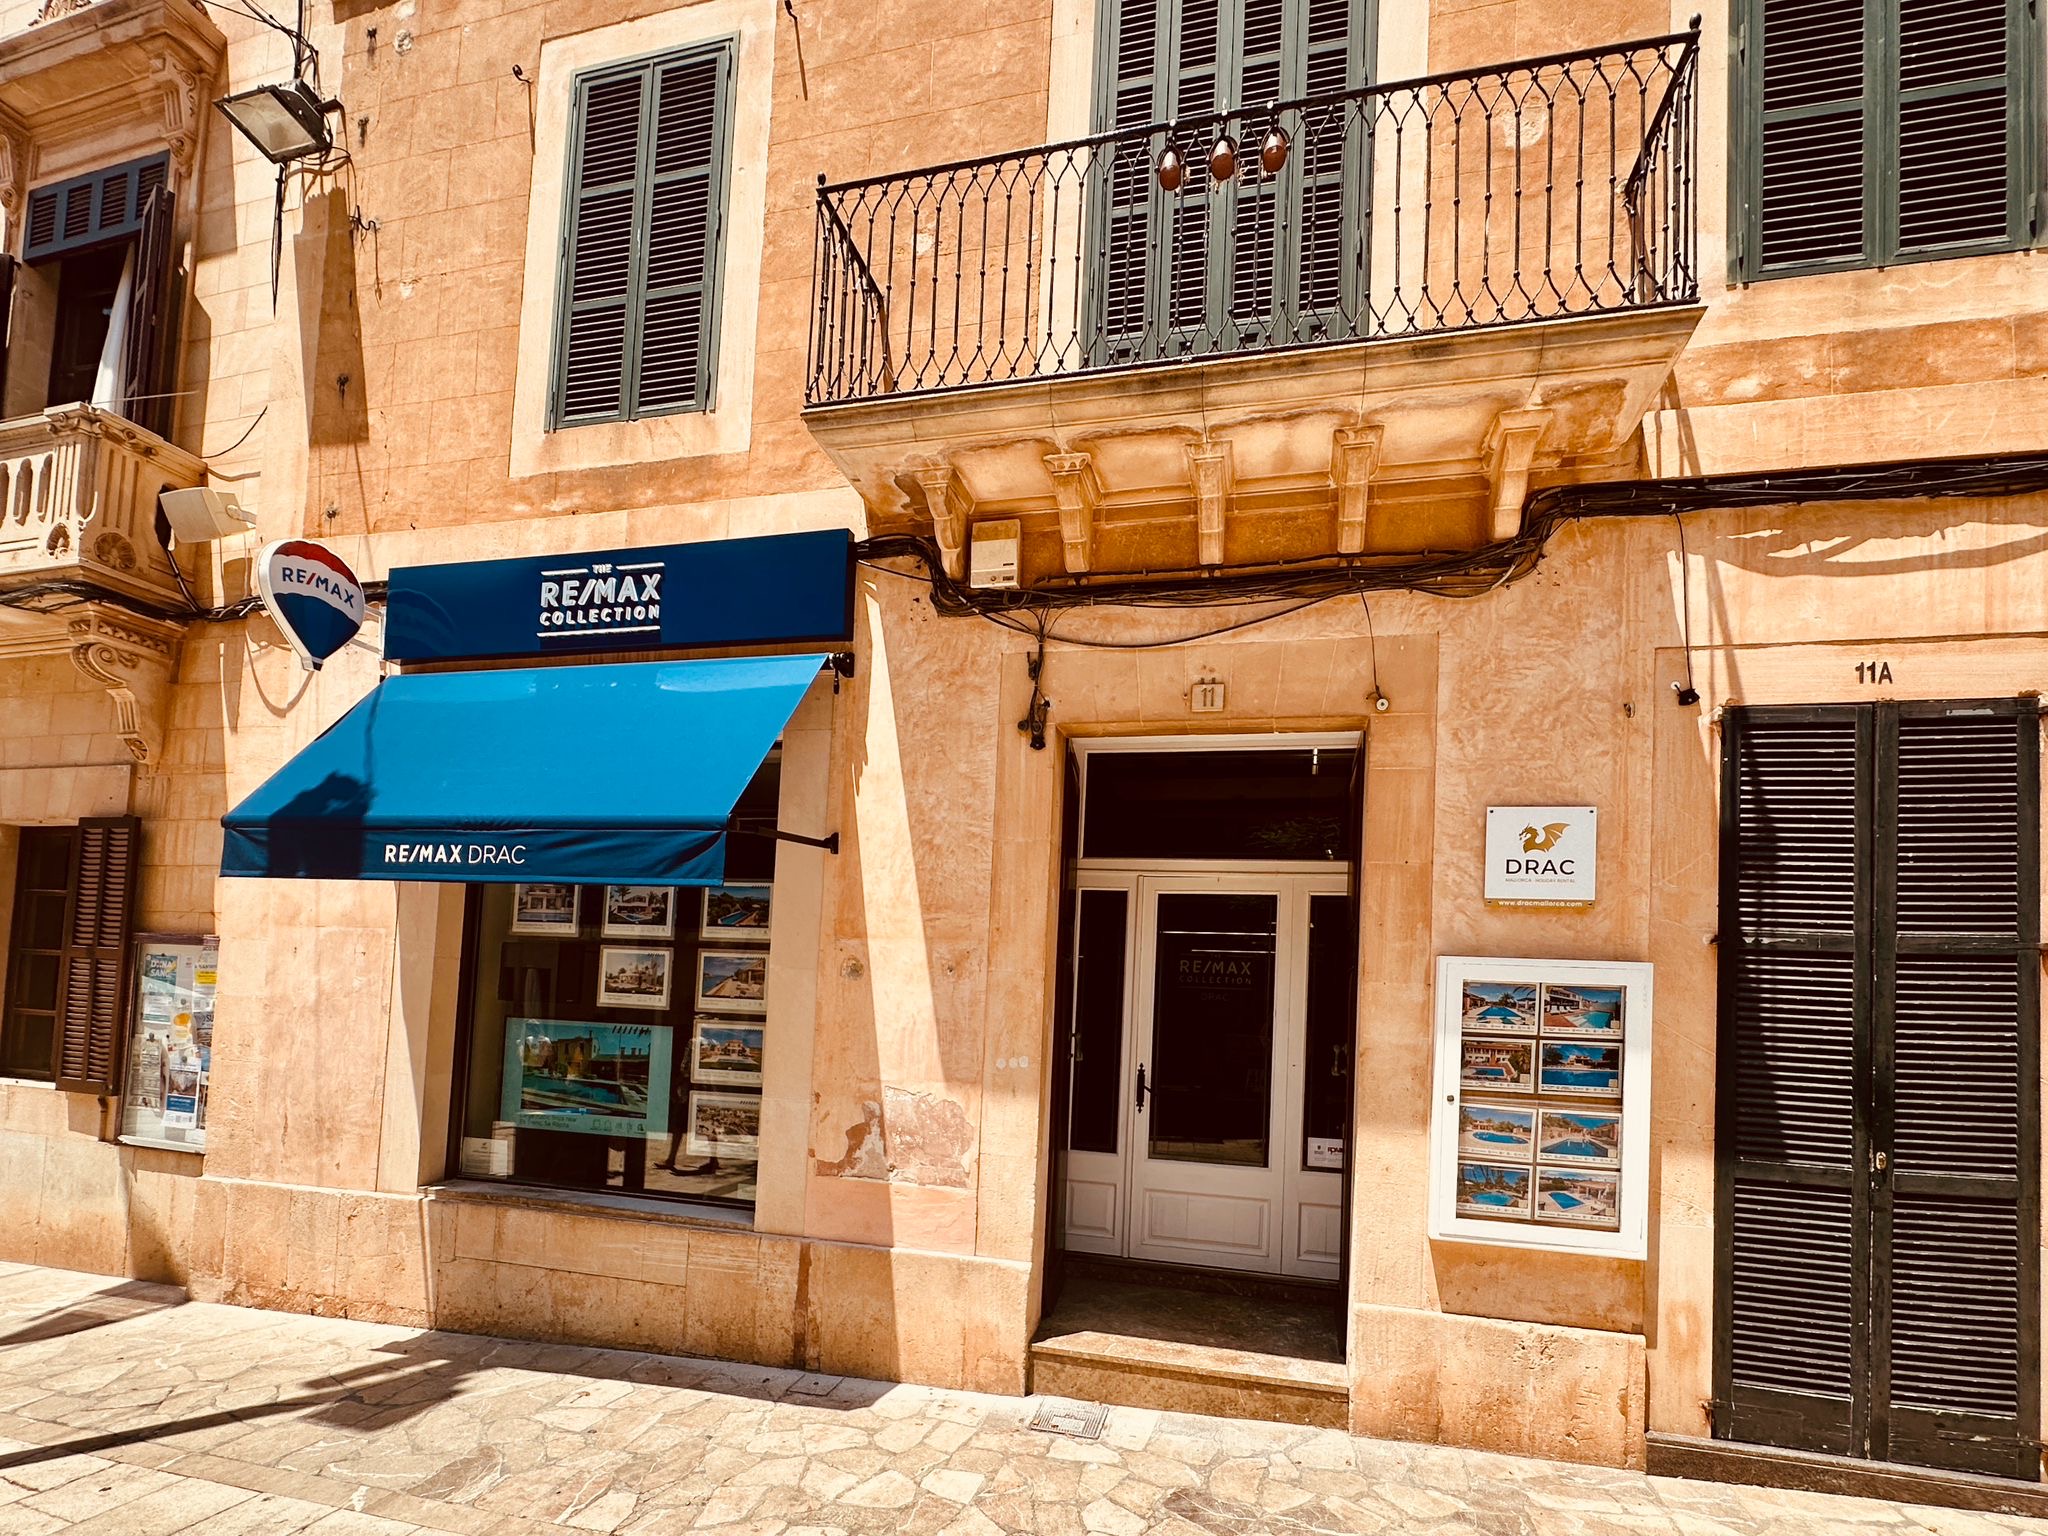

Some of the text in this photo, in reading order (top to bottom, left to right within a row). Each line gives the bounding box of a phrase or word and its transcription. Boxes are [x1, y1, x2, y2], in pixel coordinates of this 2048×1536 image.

[591, 563, 613, 574] THE
[281, 567, 355, 609] RE/MAX
[540, 573, 662, 608] RE/MAX
[539, 604, 660, 626] COLLECTION
[1854, 661, 1893, 685] 11A
[1200, 687, 1215, 707] 11
[384, 844, 527, 864] RE/MAX DRAC
[1505, 859, 1575, 876] DRAC
[1497, 899, 1583, 908] www.dracmallorca.com
[1179, 959, 1252, 975] RE/MAX
[1178, 975, 1252, 985] COLLECTION
